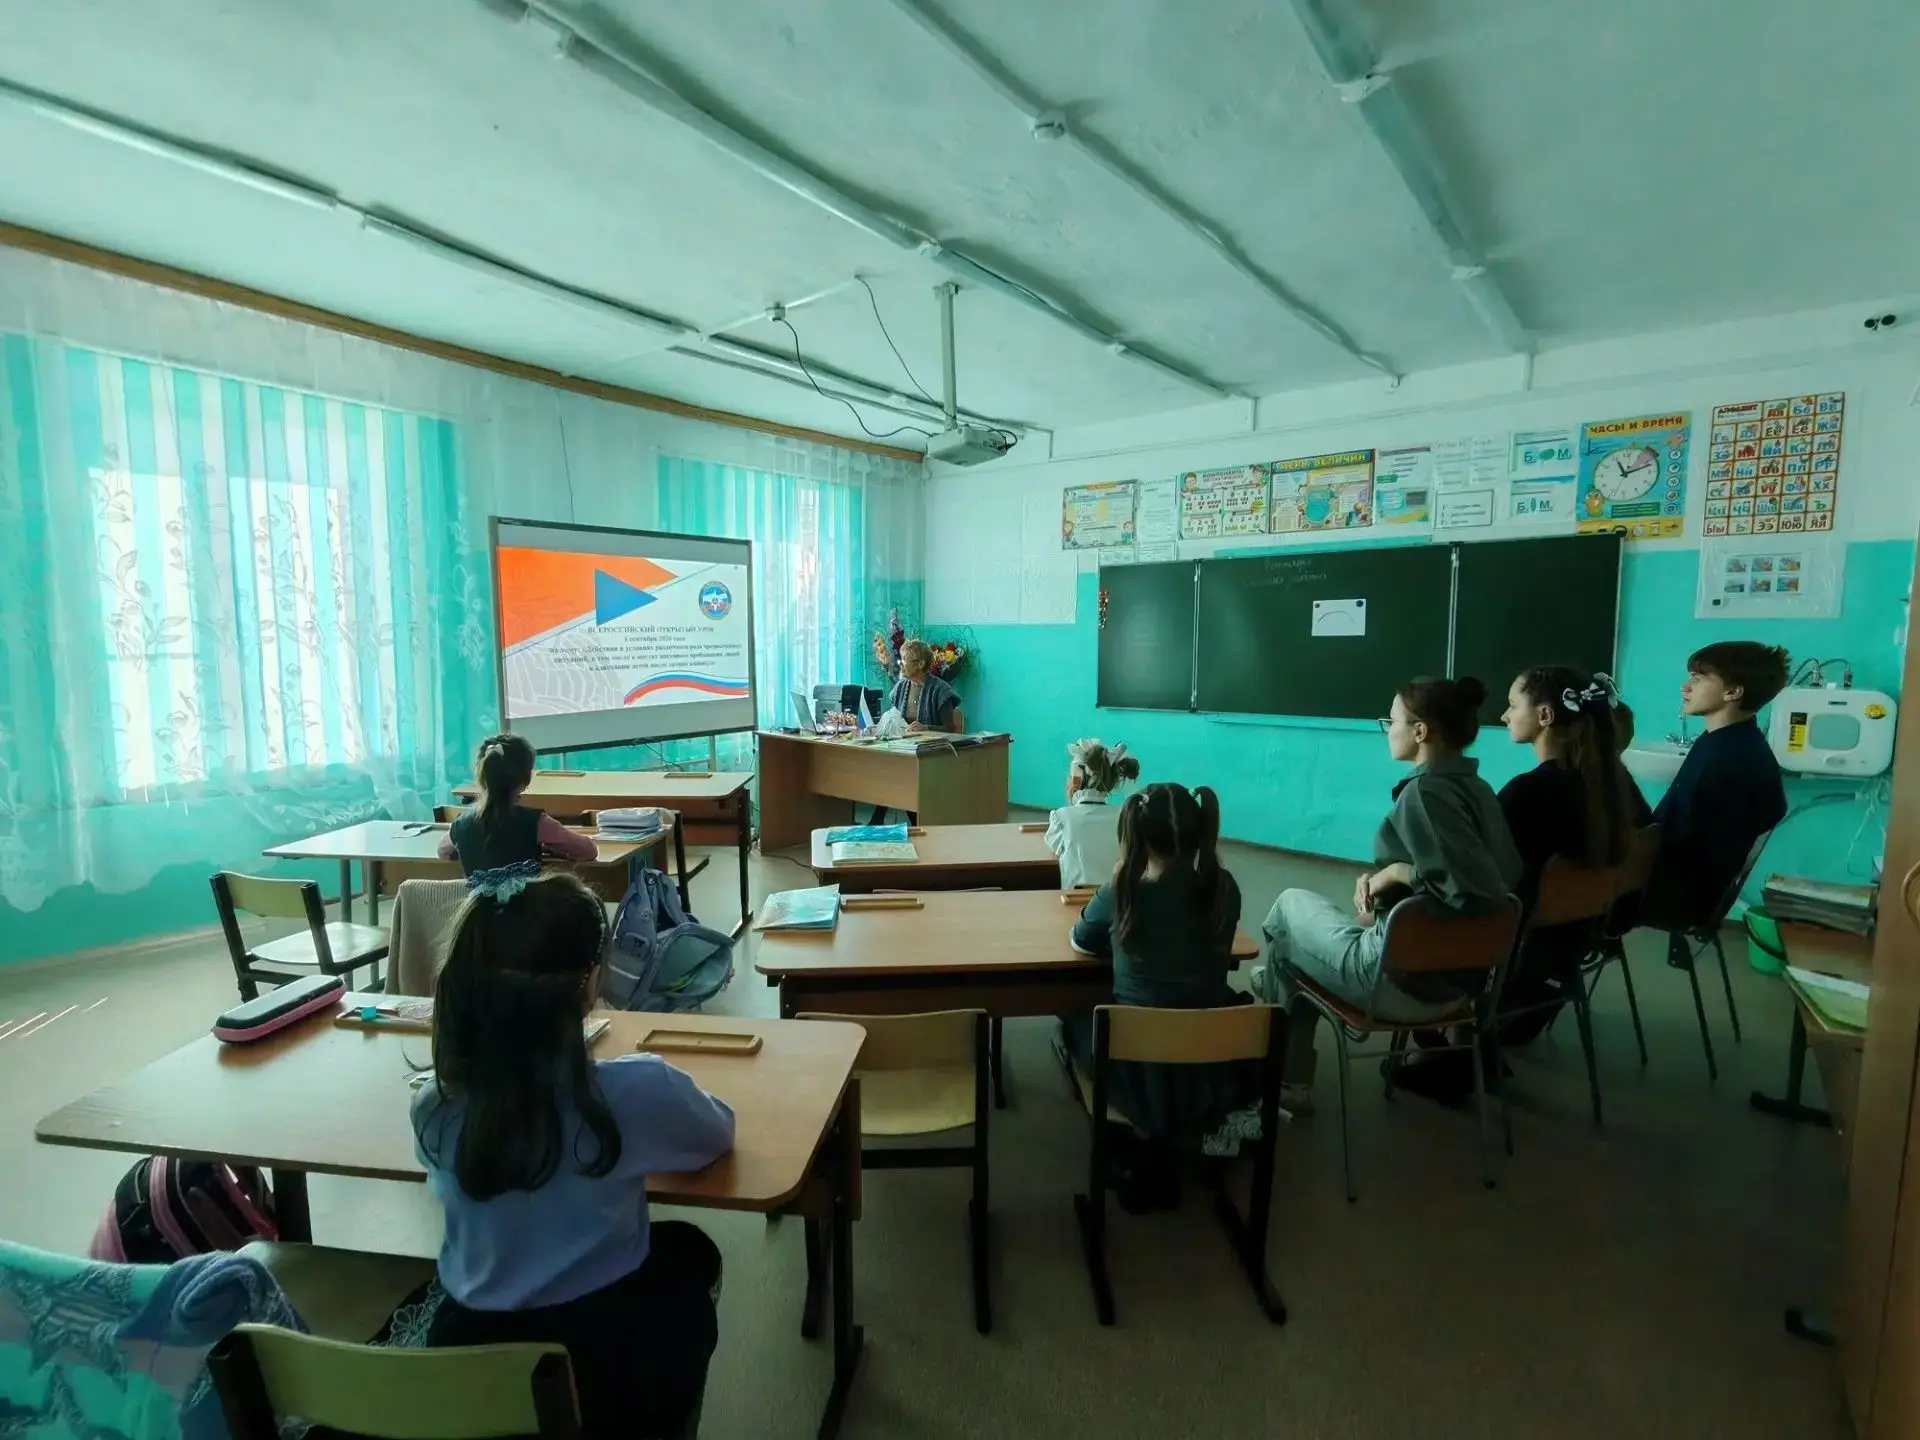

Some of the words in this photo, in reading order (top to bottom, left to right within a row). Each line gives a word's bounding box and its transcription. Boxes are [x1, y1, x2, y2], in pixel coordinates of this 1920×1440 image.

[1590, 423, 1625, 434] ЧАСЫ
[1629, 422, 1638, 430] И
[1643, 415, 1683, 428] ВРЕМЯ
[1524, 451, 1537, 463] Б.
[1557, 448, 1572, 459] М.
[1788, 463, 1806, 472] Пп
[1517, 502, 1530, 512] Б.
[1540, 500, 1553, 510] М.
[1814, 500, 1827, 510] Ъ
[1736, 523, 1746, 532] Ь
[1758, 521, 1774, 531] Ээ
[1781, 520, 1802, 530] Юю
[588, 625, 655, 633] ВСЕРОССИЙСКИЙ
[629, 635, 657, 643] сентября
